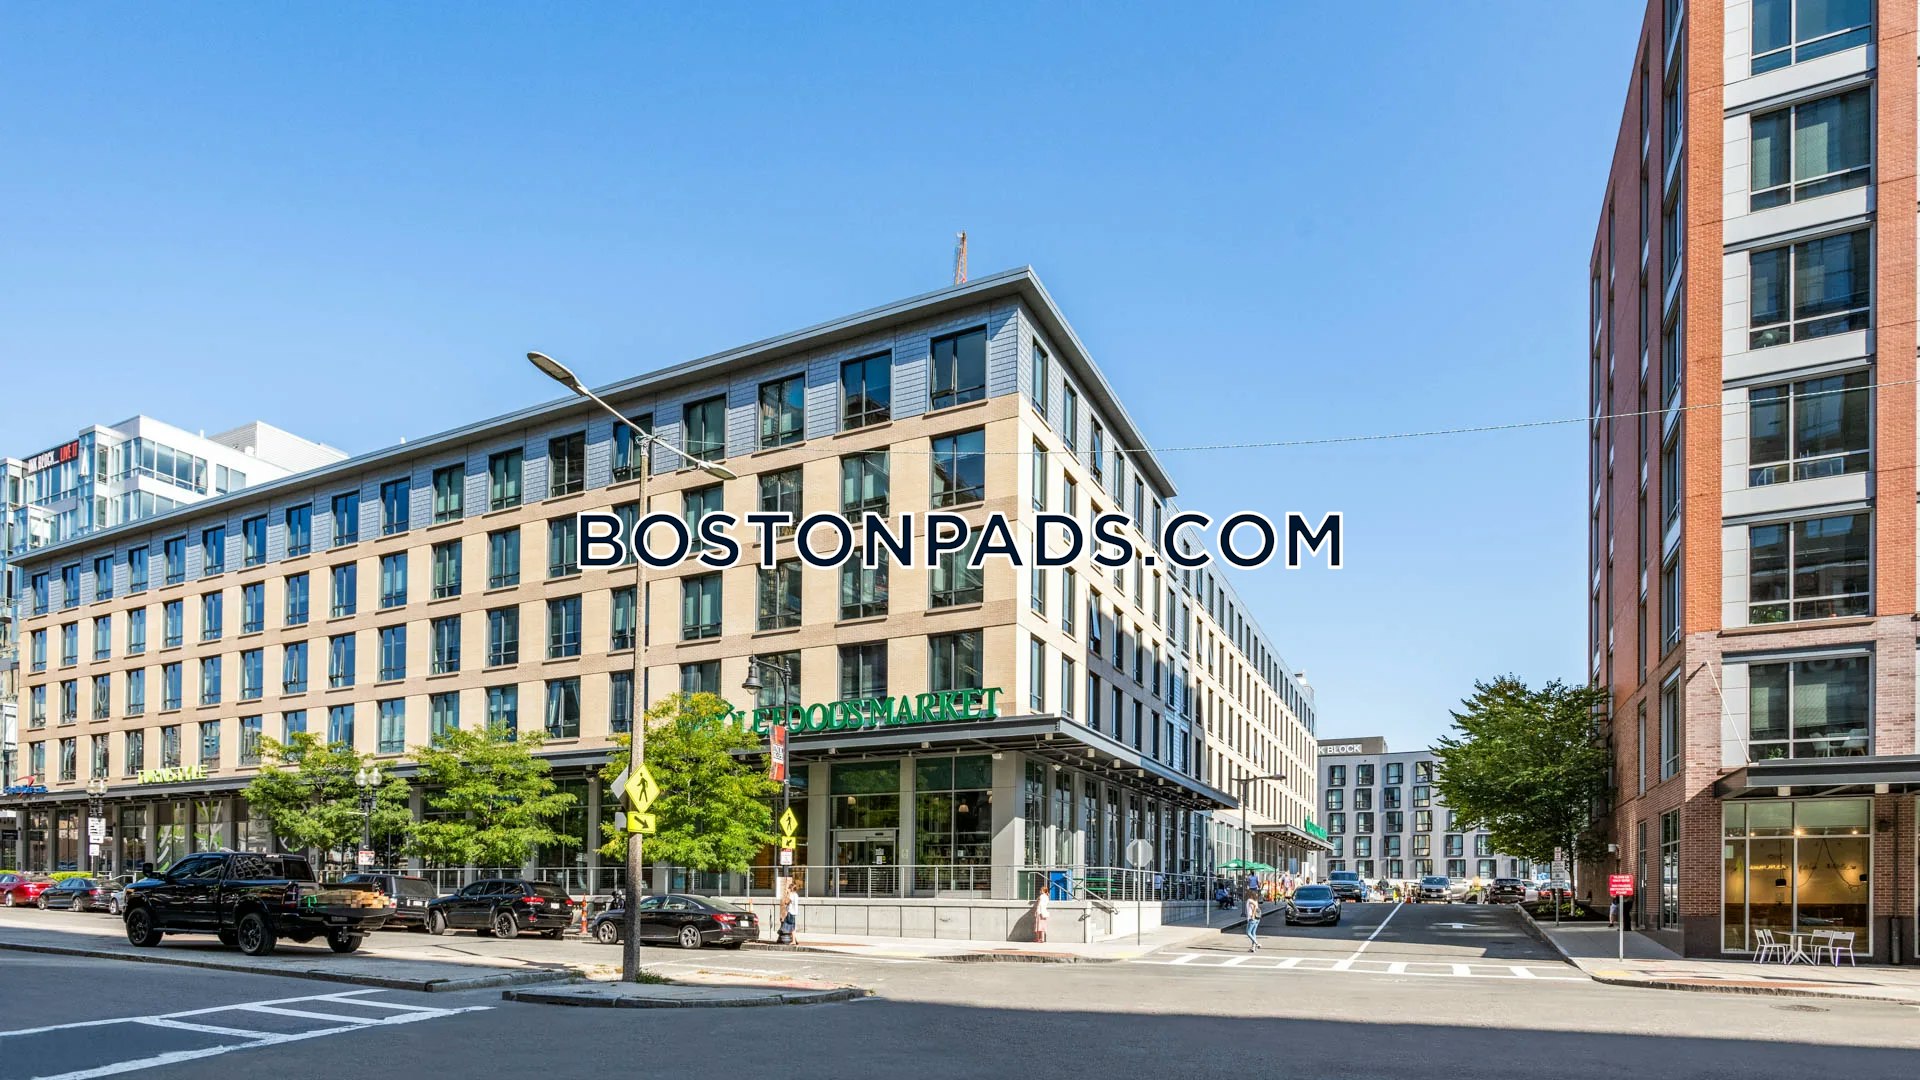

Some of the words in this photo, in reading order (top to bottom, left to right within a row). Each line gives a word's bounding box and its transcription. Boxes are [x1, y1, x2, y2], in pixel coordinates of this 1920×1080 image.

[867, 686, 1004, 728] MARKET
[1327, 744, 1361, 754] BLOCK
[136, 764, 208, 785] TURNSTYLE
